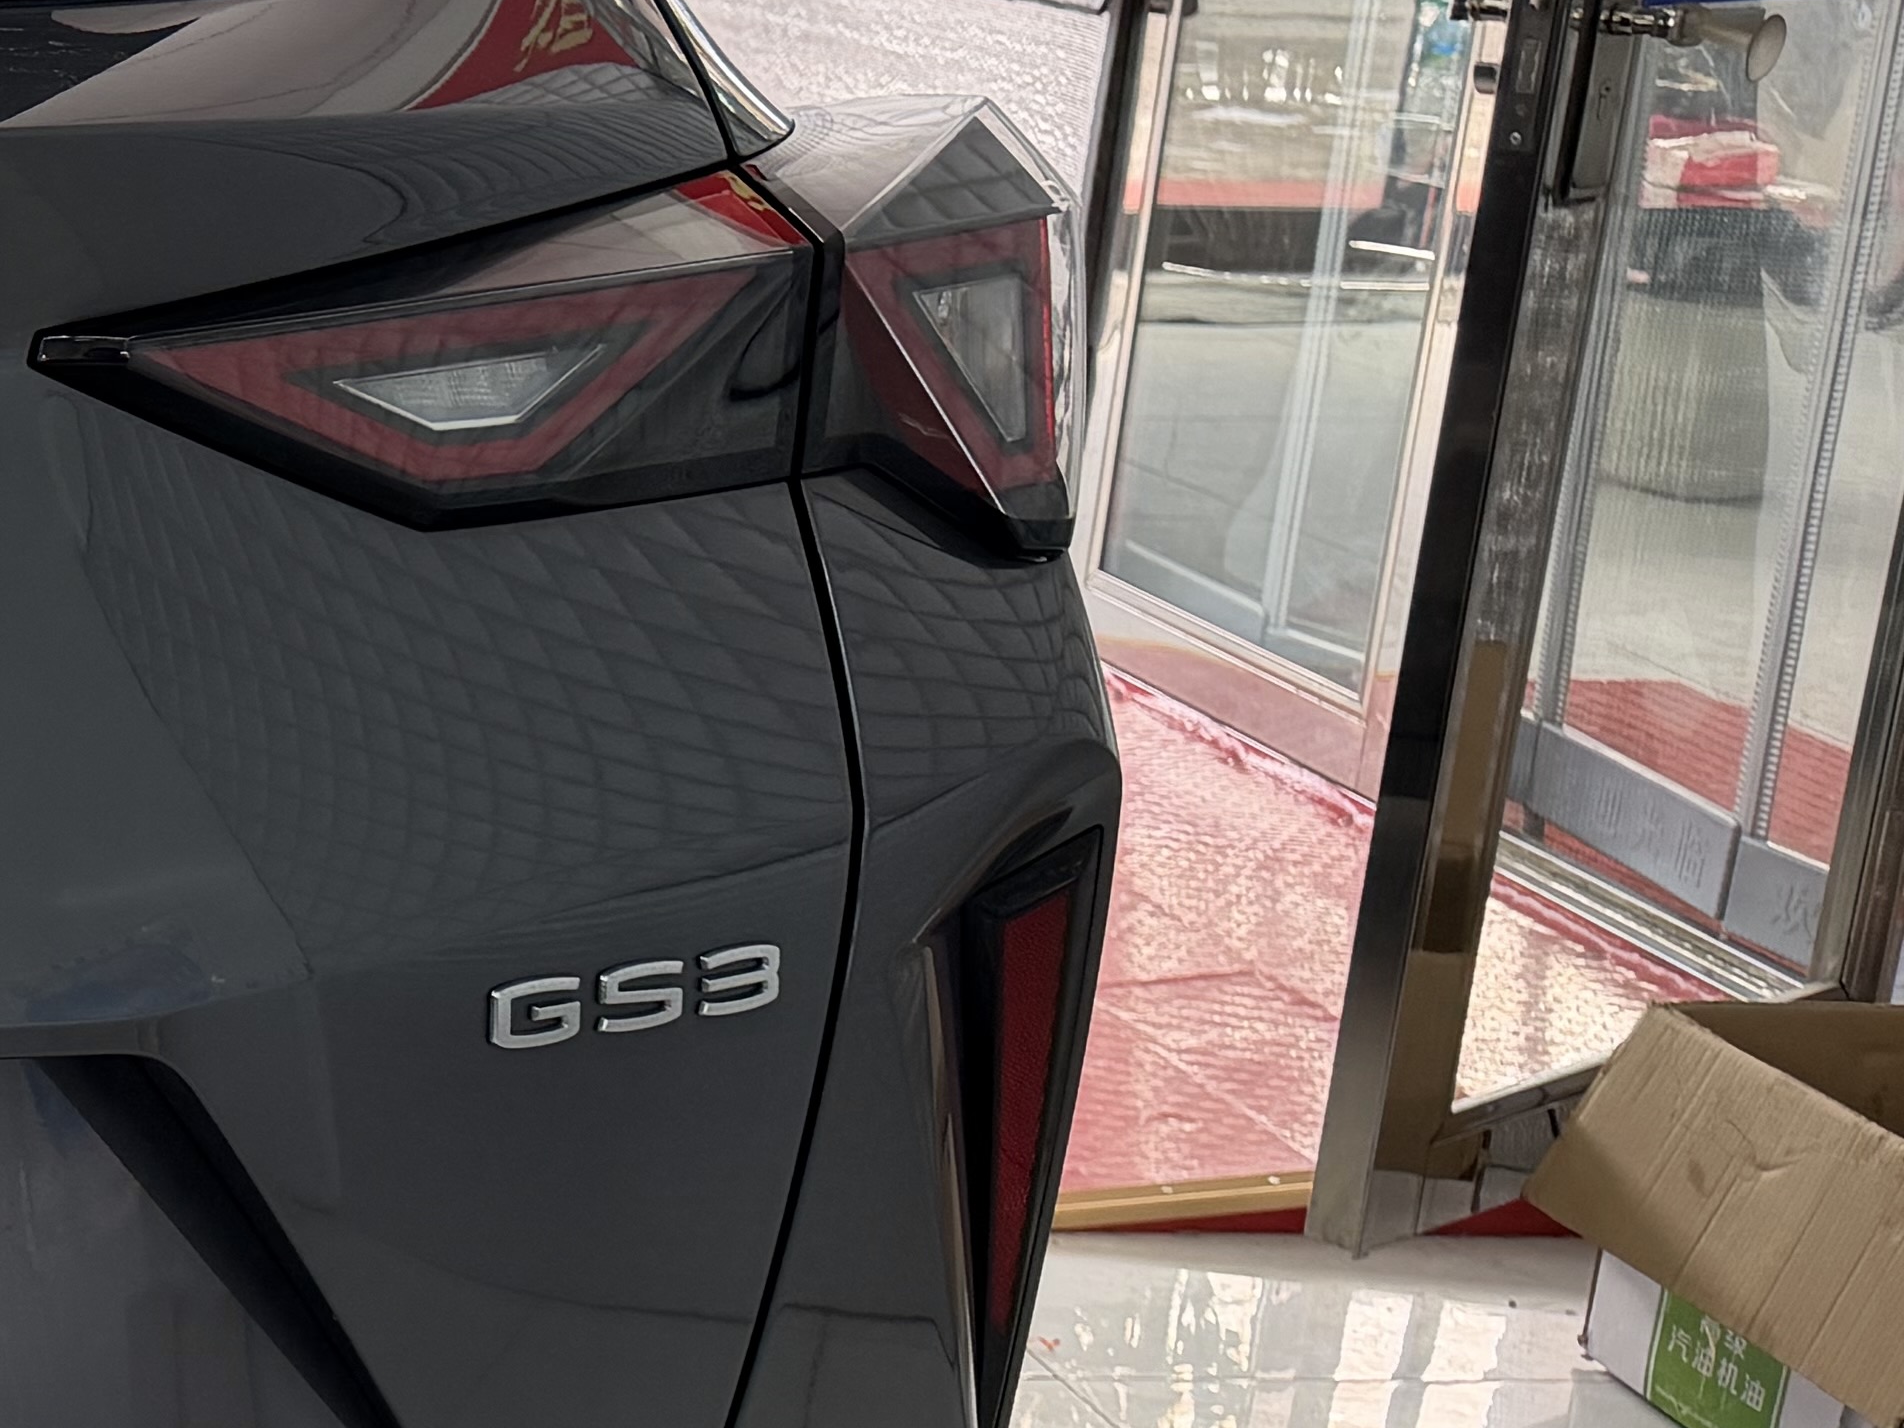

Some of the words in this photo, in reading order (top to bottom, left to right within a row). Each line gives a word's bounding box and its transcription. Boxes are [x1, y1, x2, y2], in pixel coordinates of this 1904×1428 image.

[489, 943, 780, 1049] GS3
[1667, 1324, 1766, 1412] 汽油机油
